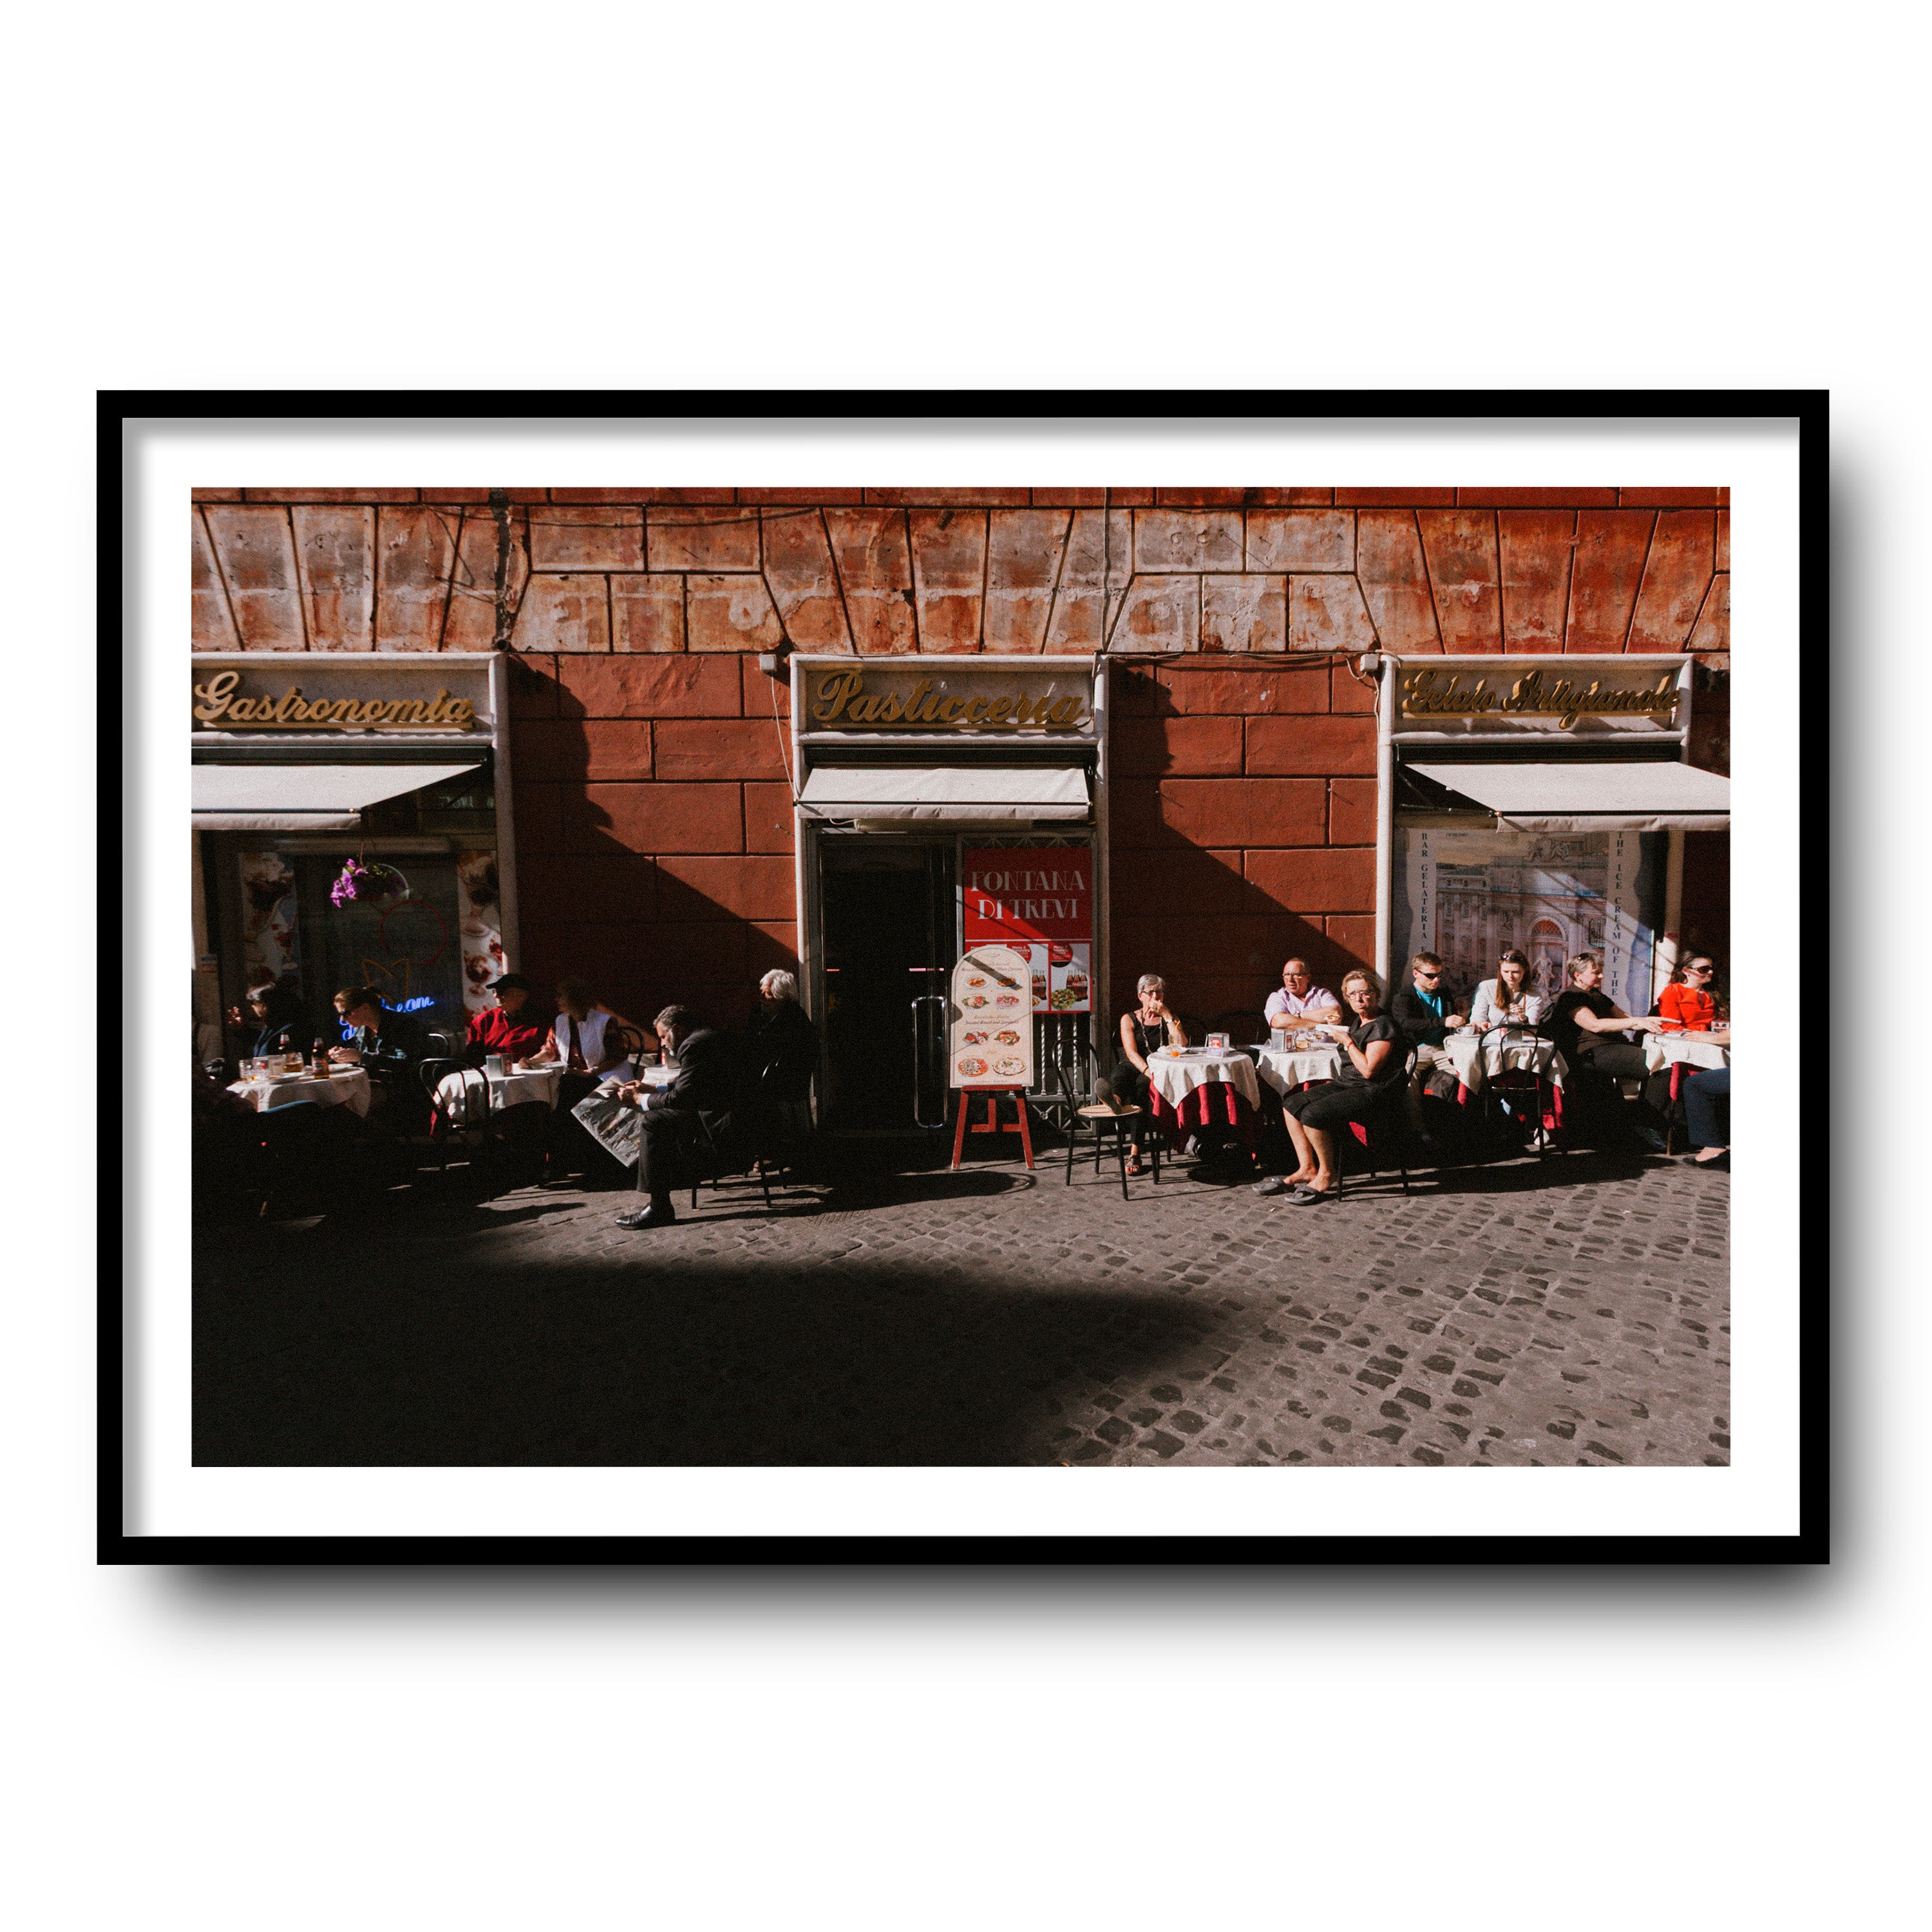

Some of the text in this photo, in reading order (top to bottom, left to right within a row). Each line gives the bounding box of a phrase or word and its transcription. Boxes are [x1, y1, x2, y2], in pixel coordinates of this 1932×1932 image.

[194, 671, 477, 723] Gastronomia
[813, 668, 1085, 723] Pasticceria
[1402, 670, 1681, 730] Gelato Artigianale
[1616, 831, 1624, 857] THE
[970, 870, 1086, 892] FONTANA
[978, 898, 1079, 920] DI TREVI
[1613, 896, 1622, 940] CREAM
[1612, 947, 1620, 964] OF
[1611, 971, 1620, 996] THE
